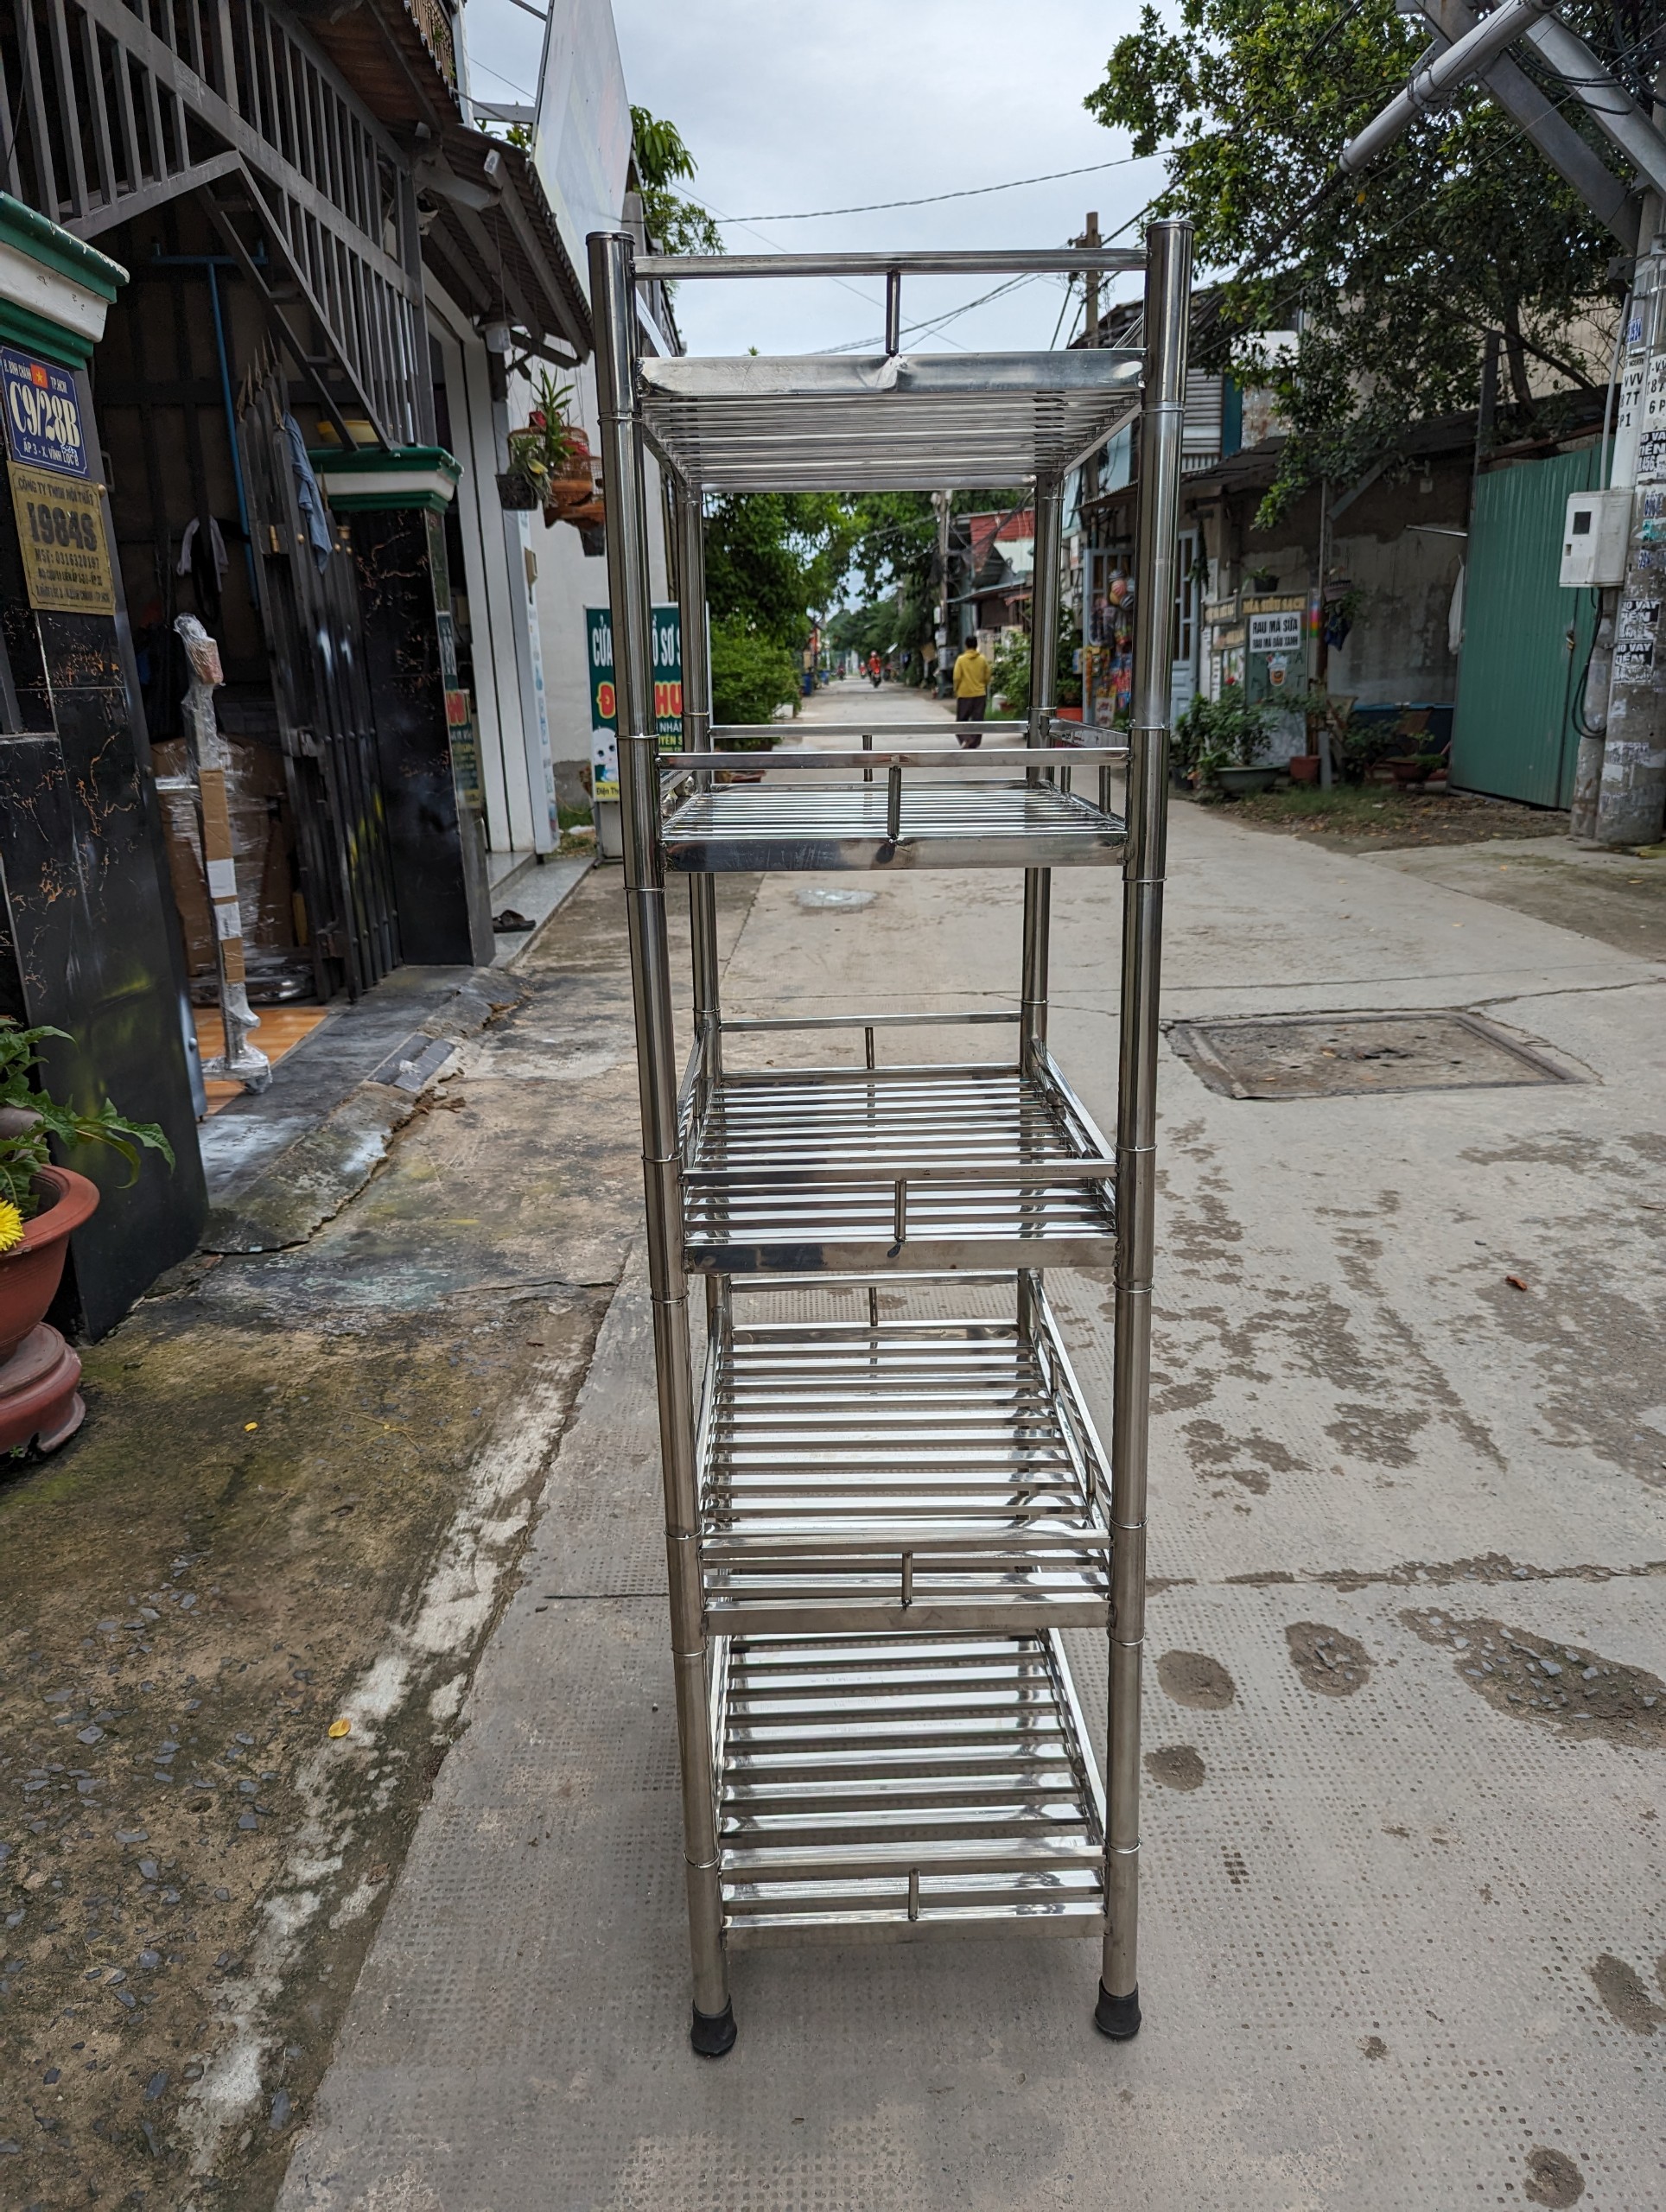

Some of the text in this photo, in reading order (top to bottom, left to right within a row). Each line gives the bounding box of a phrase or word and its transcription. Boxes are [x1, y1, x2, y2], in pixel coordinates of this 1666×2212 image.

[10, 381, 80, 448] C9/28B
[1651, 431, 1666, 441] VA
[23, 437, 31, 454] ẤP
[33, 444, 37, 455] 3
[41, 446, 48, 458] X.
[48, 445, 62, 461] VĨNH
[18, 474, 37, 493] CÔNG
[37, 482, 46, 495] TY
[47, 483, 65, 499] TNHH
[1253, 617, 1298, 634] RAU MÁ SỮA
[592, 614, 613, 667] CỬA
[660, 623, 674, 667] SƠ
[1629, 643, 1652, 652] VAY
